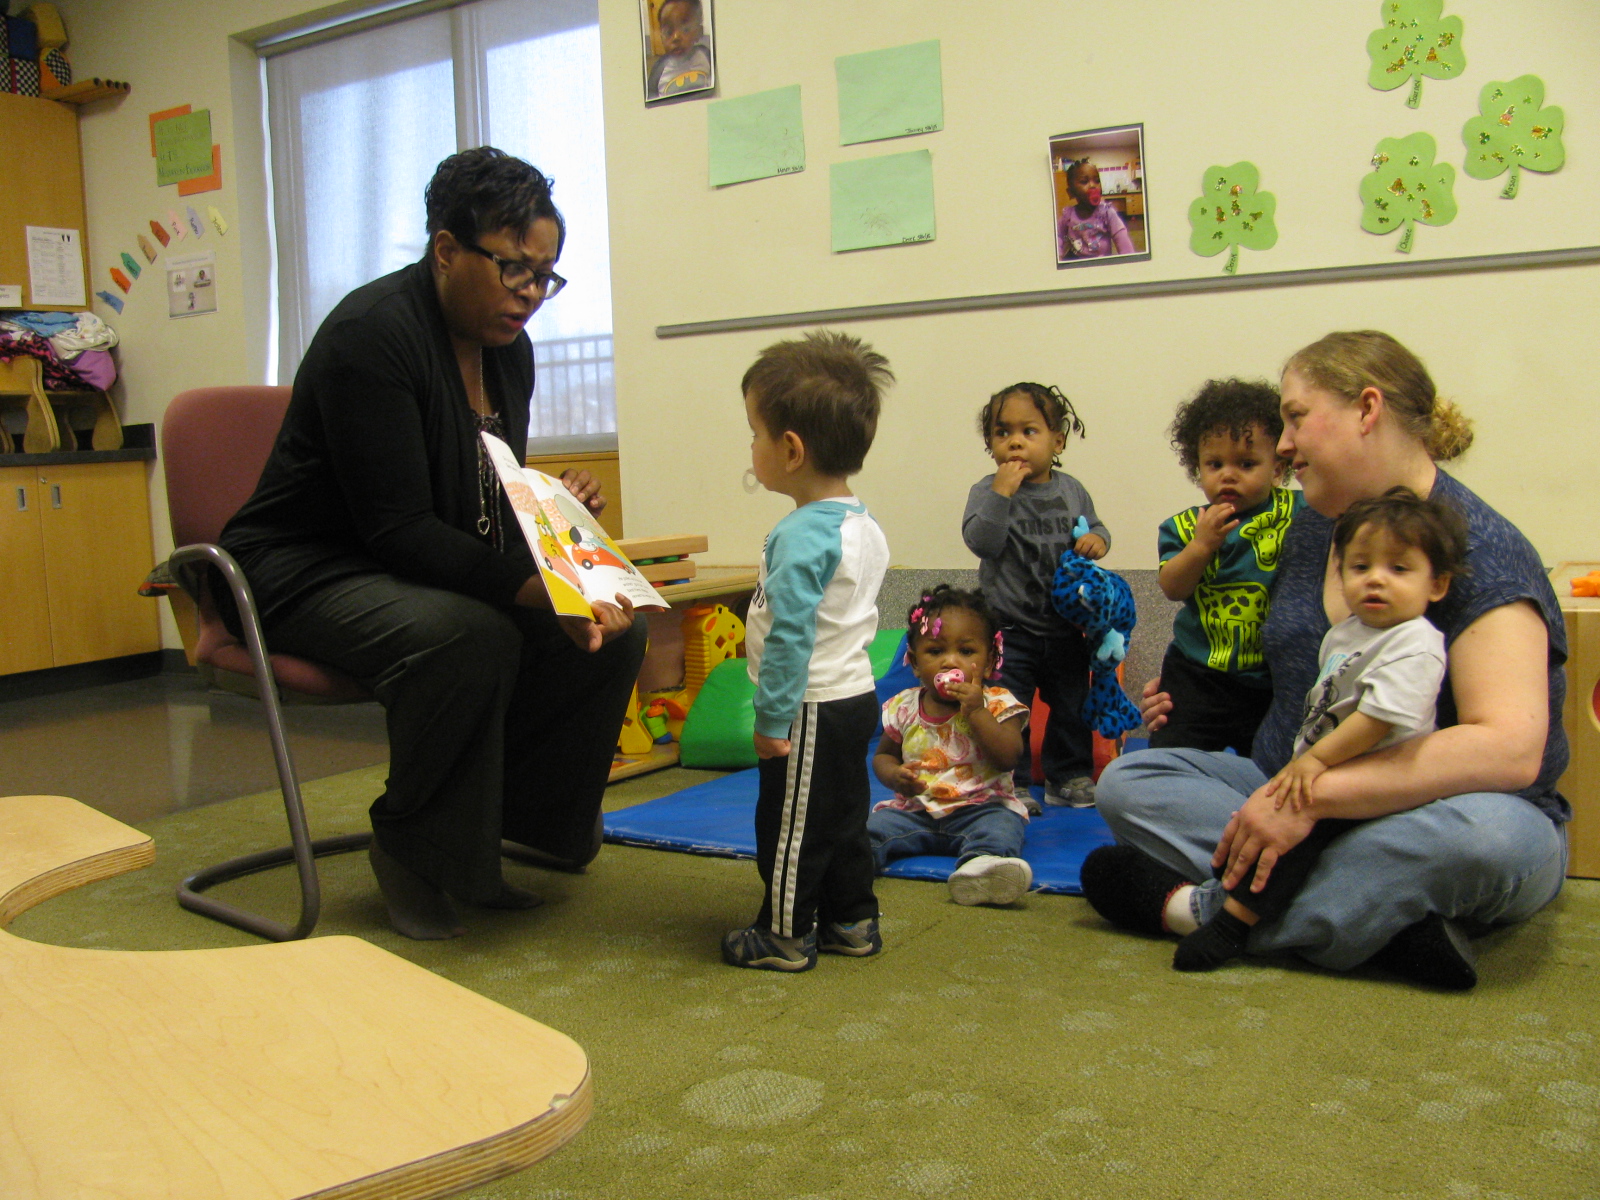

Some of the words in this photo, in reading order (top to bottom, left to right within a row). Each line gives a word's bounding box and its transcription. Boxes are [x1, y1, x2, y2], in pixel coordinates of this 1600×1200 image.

[1408, 79, 1421, 105] Journey
[1503, 175, 1517, 196] Mason
[1225, 253, 1238, 273] Derek
[1016, 517, 1052, 536] THIS
[1056, 516, 1069, 534] IS
